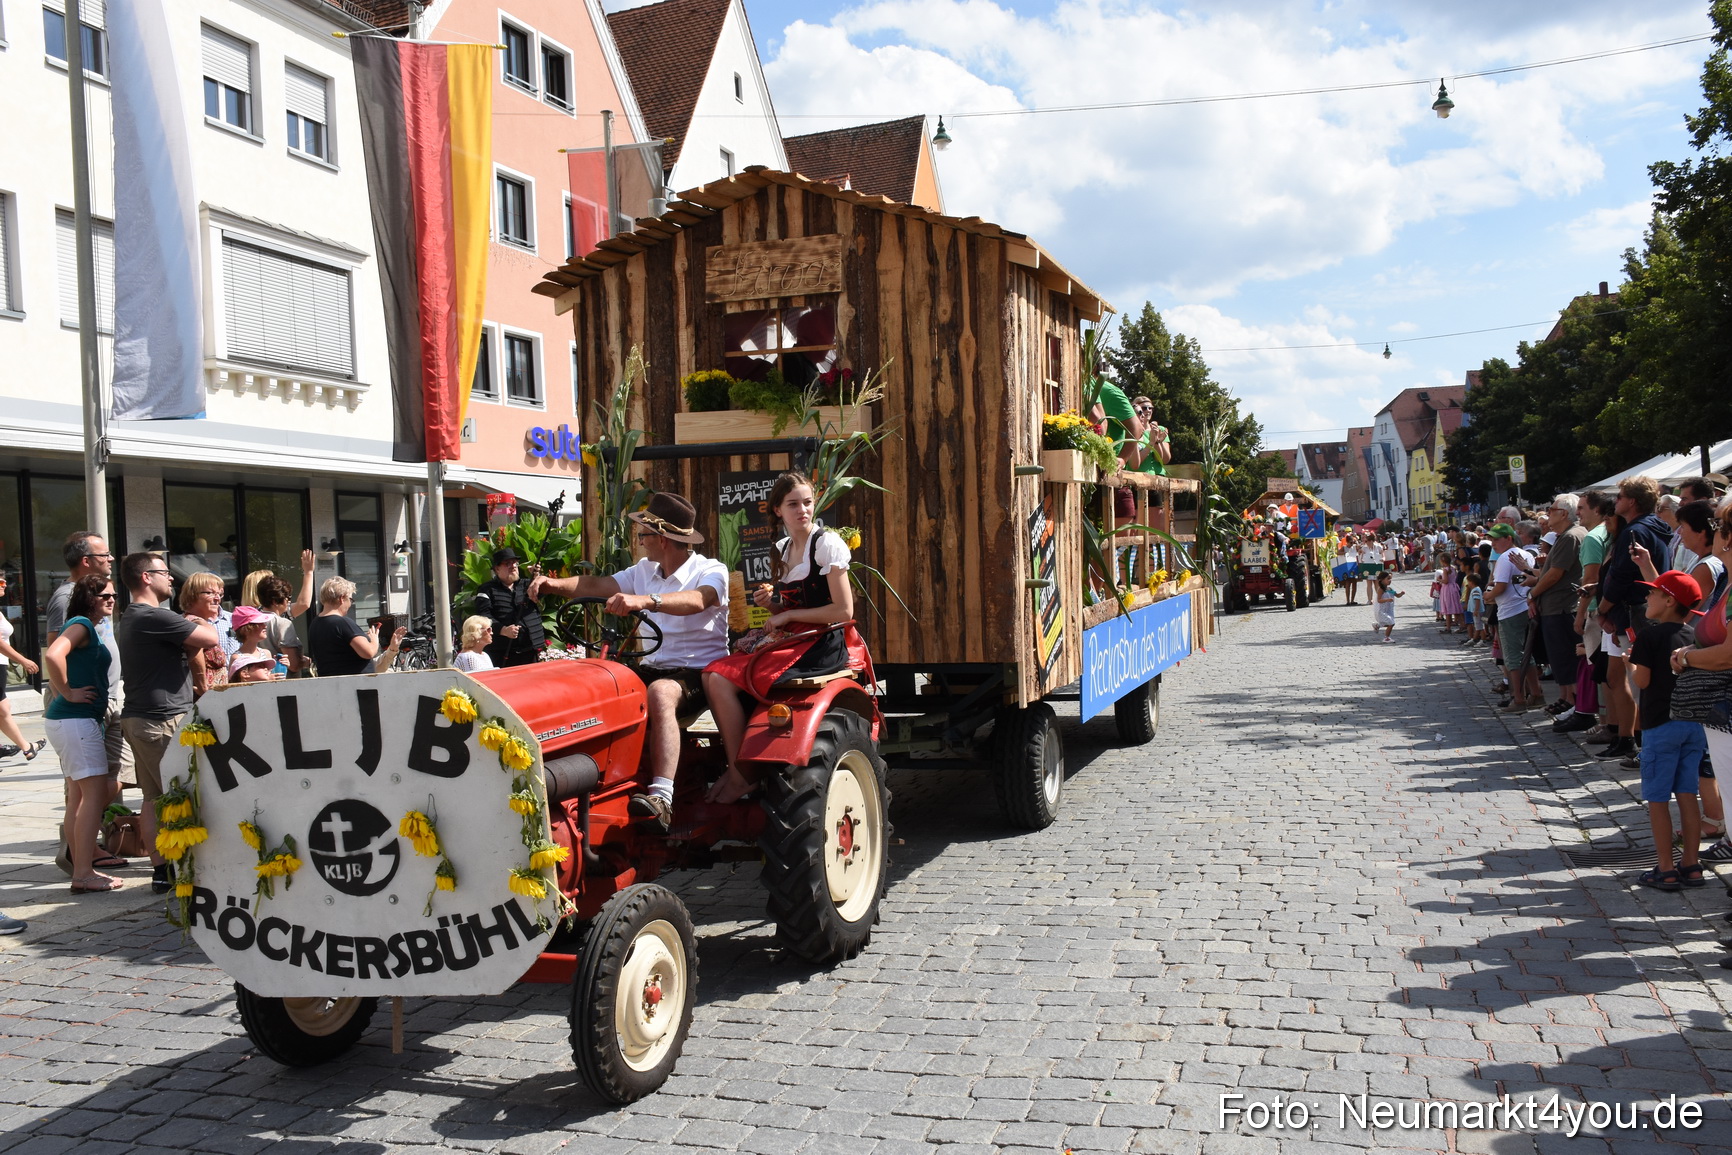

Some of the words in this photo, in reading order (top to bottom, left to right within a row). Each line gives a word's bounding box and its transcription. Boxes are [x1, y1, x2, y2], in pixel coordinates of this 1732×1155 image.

[722, 486, 734, 494] 19.
[735, 478, 777, 492] WORLDW
[743, 526, 772, 537] SAMST
[536, 726, 567, 741] RSCHE
[570, 717, 602, 731] DIESEL
[202, 689, 473, 793] KLJB
[324, 863, 363, 884] KLJB
[189, 886, 552, 980] RÖCKERSBÜHL
